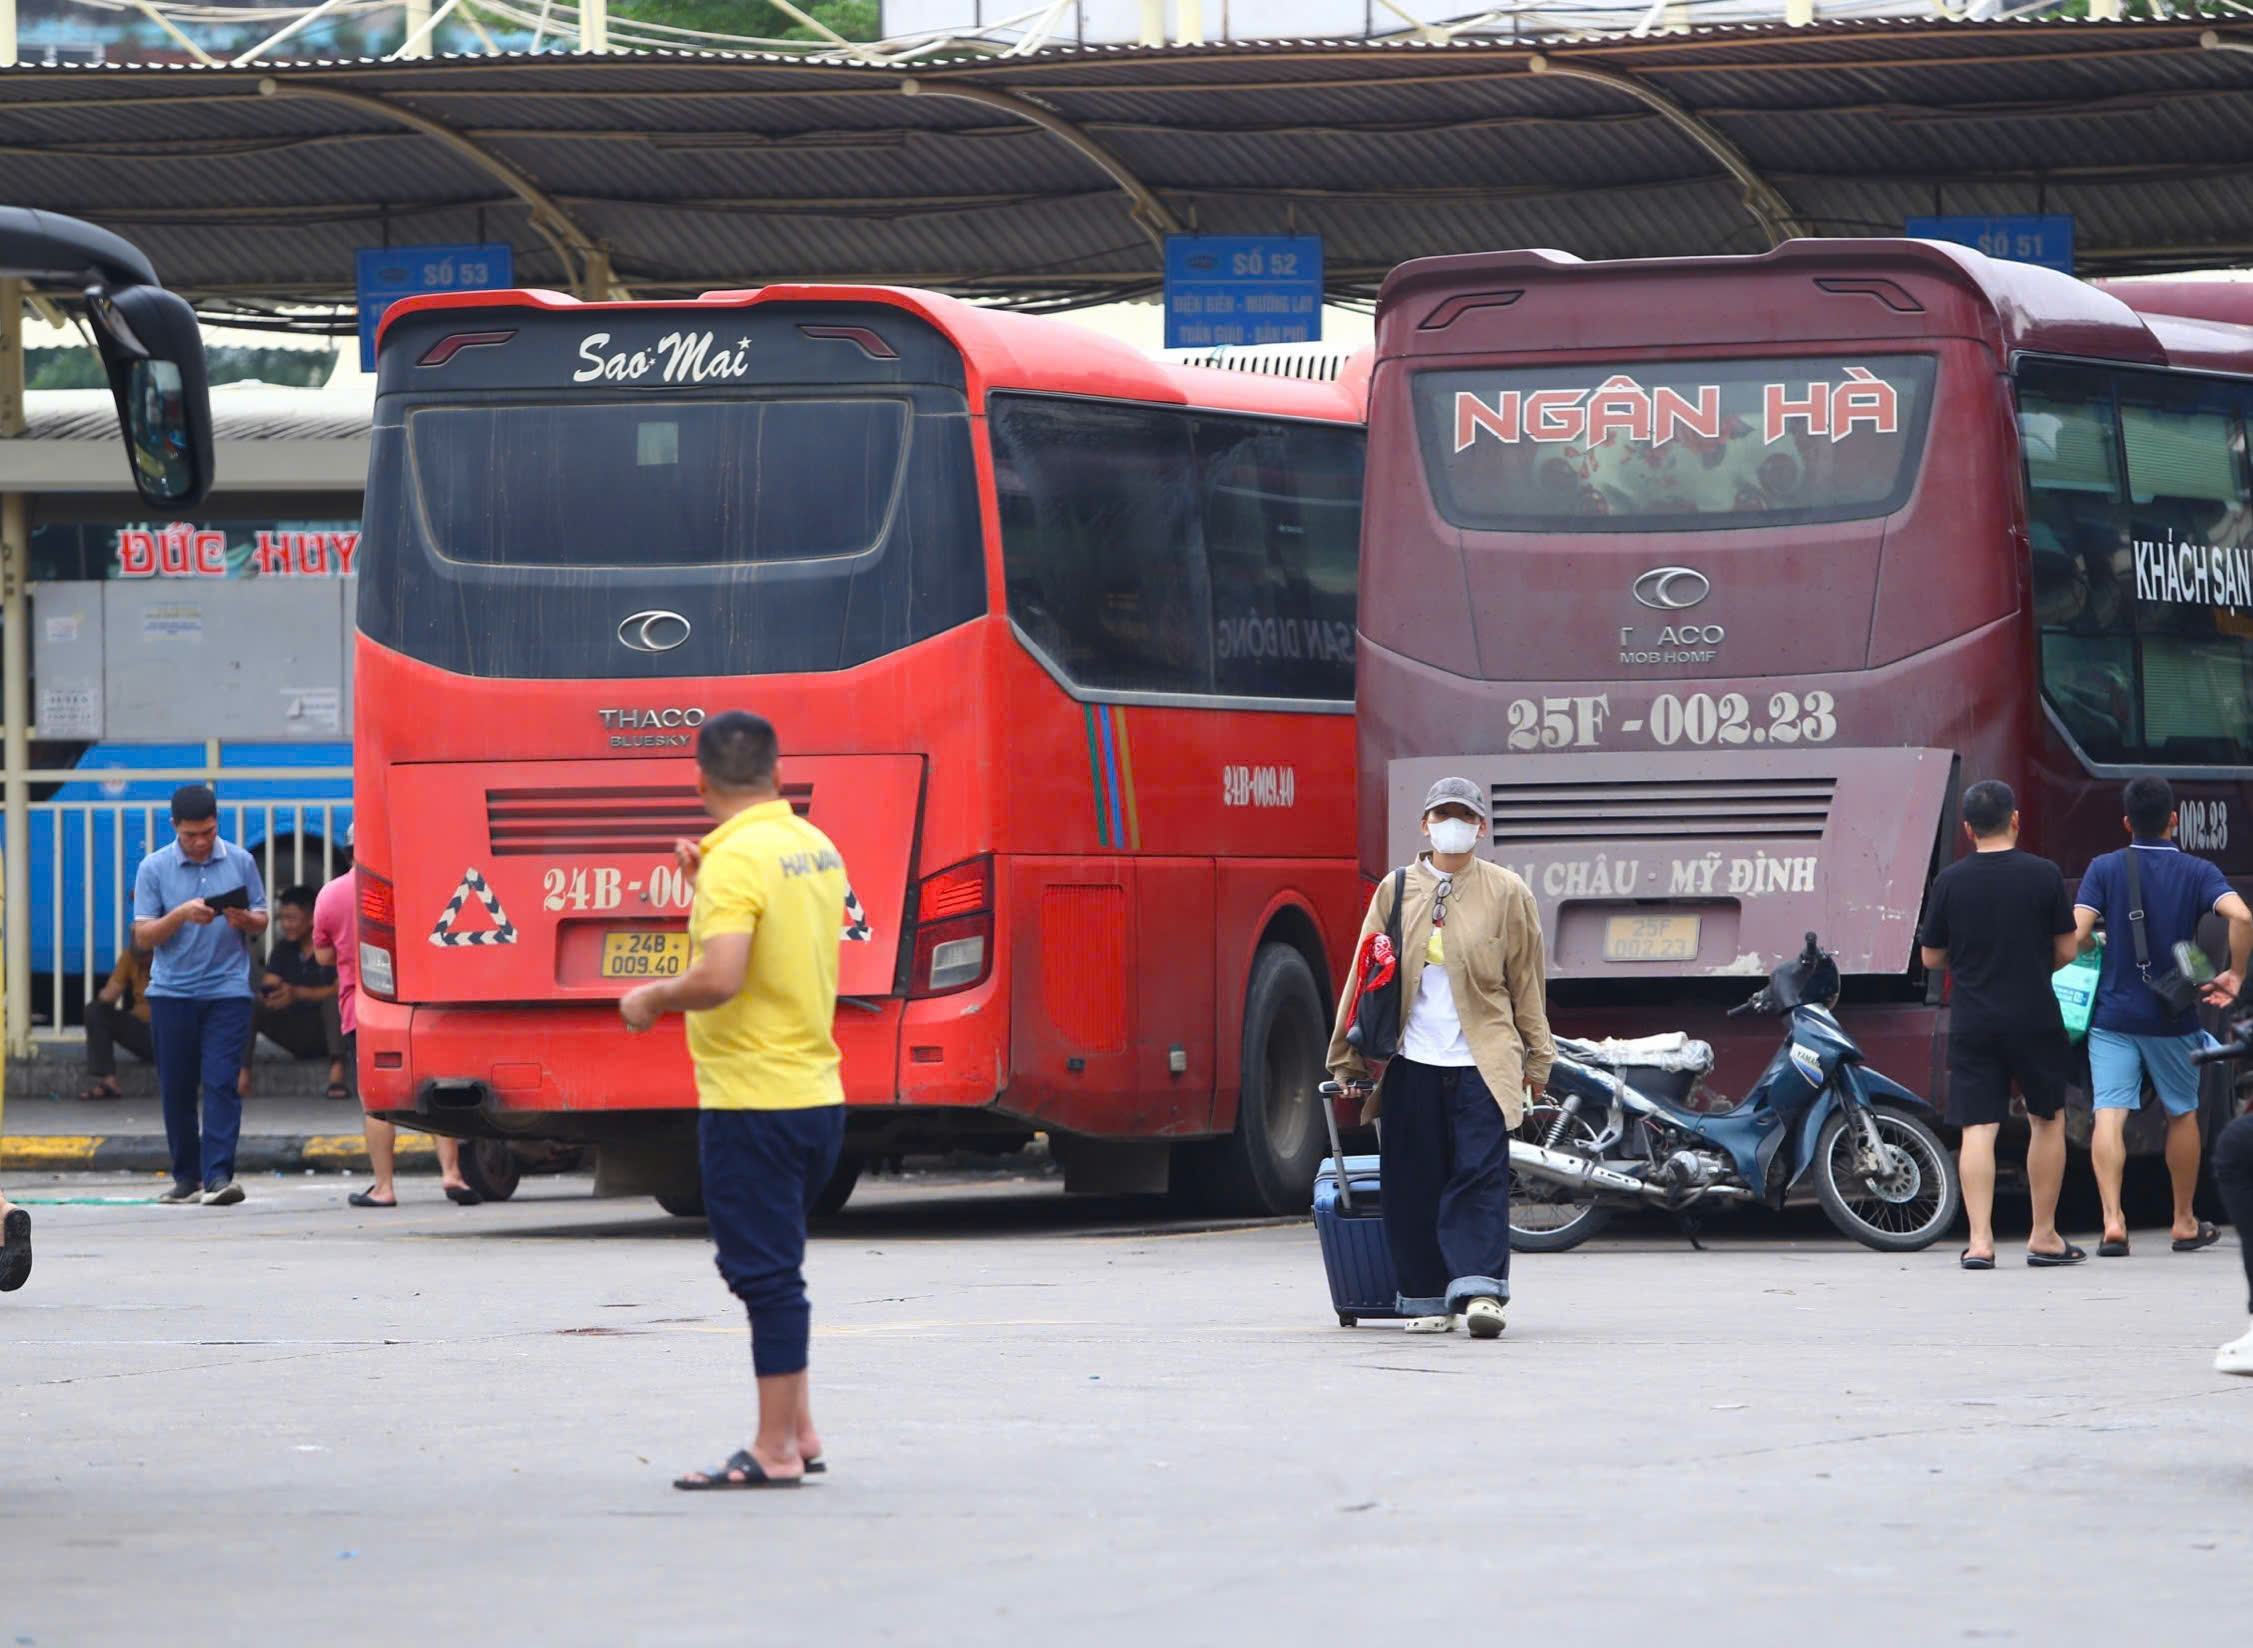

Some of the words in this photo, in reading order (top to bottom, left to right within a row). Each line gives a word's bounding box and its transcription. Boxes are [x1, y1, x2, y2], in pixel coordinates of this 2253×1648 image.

[1232, 245, 1264, 275] SỐ
[1271, 253, 1297, 275] 52
[2016, 234, 2043, 257] 51
[423, 255, 455, 286] SỐ
[461, 263, 488, 285] 53
[573, 332, 650, 382] Sao
[657, 331, 752, 382] Mai
[1454, 374, 1720, 454] NGÂN
[1763, 366, 1898, 446] HÀ
[115, 521, 227, 578] ĐỨC
[252, 529, 361, 577] HUY
[2133, 528, 2210, 605] KHÁCH
[2211, 545, 2253, 617] SẠN
[598, 708, 706, 729] THACO
[610, 735, 691, 748] BLUESKY
[543, 865, 694, 911] 24B-00
[1543, 853, 1639, 897] CHÂU
[1668, 851, 1722, 894] MỸ
[1632, 919, 1672, 937] 25F
[629, 934, 666, 953] 24B
[611, 955, 679, 974] 009.40
